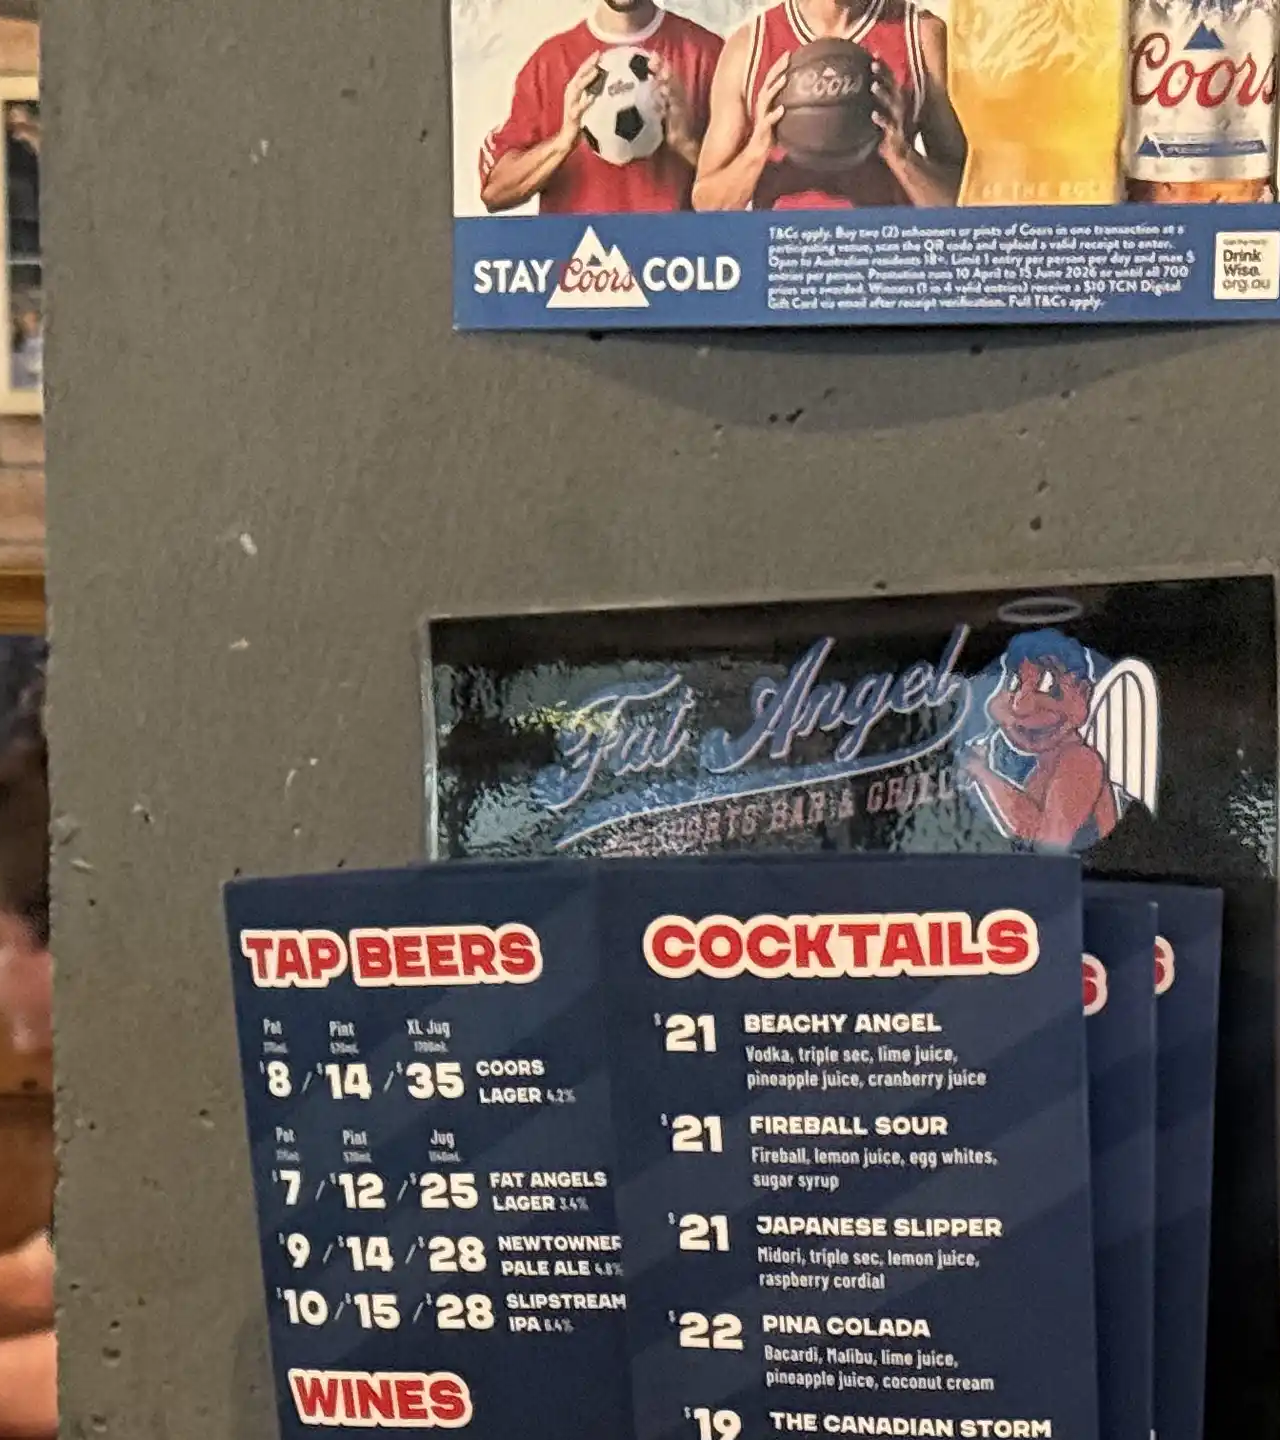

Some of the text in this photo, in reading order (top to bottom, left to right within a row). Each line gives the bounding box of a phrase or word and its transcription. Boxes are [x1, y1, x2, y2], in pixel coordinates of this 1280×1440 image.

[1131, 32, 1277, 108] Coors
[882, 226, 899, 238] (2)
[924, 240, 945, 253] QR
[1224, 249, 1261, 262] Drink
[474, 256, 741, 294] STAY Coors COLD
[1065, 266, 1097, 277] 2026
[1163, 266, 1188, 277] 700
[643, 908, 1039, 979] COCKTAILS
[240, 923, 543, 988] TAP BEERS
[426, 1020, 451, 1038] Jug
[744, 1013, 847, 1033] BEACHY
[855, 1013, 942, 1033] ANGEL
[746, 1045, 958, 1066] Vodka, triple sec, lime juice,
[476, 1060, 544, 1076] COORS
[747, 1069, 987, 1091] pineapple juice, cranberry juice
[479, 1087, 542, 1104] LAGER
[750, 1116, 867, 1136] FIREBALL
[875, 1116, 948, 1135] SOUR
[431, 1130, 454, 1148] Jug
[752, 1146, 998, 1167] Fireball, lemon juice, egg whites,
[489, 1172, 524, 1188] FAT
[531, 1172, 607, 1188] ANGELS
[753, 1174, 839, 1190] sugar syrup
[492, 1195, 556, 1211] LAGER
[756, 1216, 887, 1237] JAPANESE
[894, 1217, 1002, 1238] SLIPPER
[757, 1246, 980, 1269] Midori, triple sec, lemon juice,
[501, 1261, 591, 1276] PALE ALE
[759, 1272, 885, 1291] raspberry cordial
[506, 1293, 627, 1310] SLIPSTREAM
[508, 1317, 541, 1332] IPA
[762, 1314, 821, 1335] PINA
[826, 1317, 932, 1337] COLADA
[765, 1345, 958, 1369] Bacardi, Malibu, lime juice,
[766, 1370, 994, 1391] pineapple juice, coconut cream
[288, 1367, 472, 1428] WINES
[769, 1411, 817, 1432] THE
[823, 1413, 954, 1437] CANADIAN
[960, 1419, 1052, 1439] STORM
